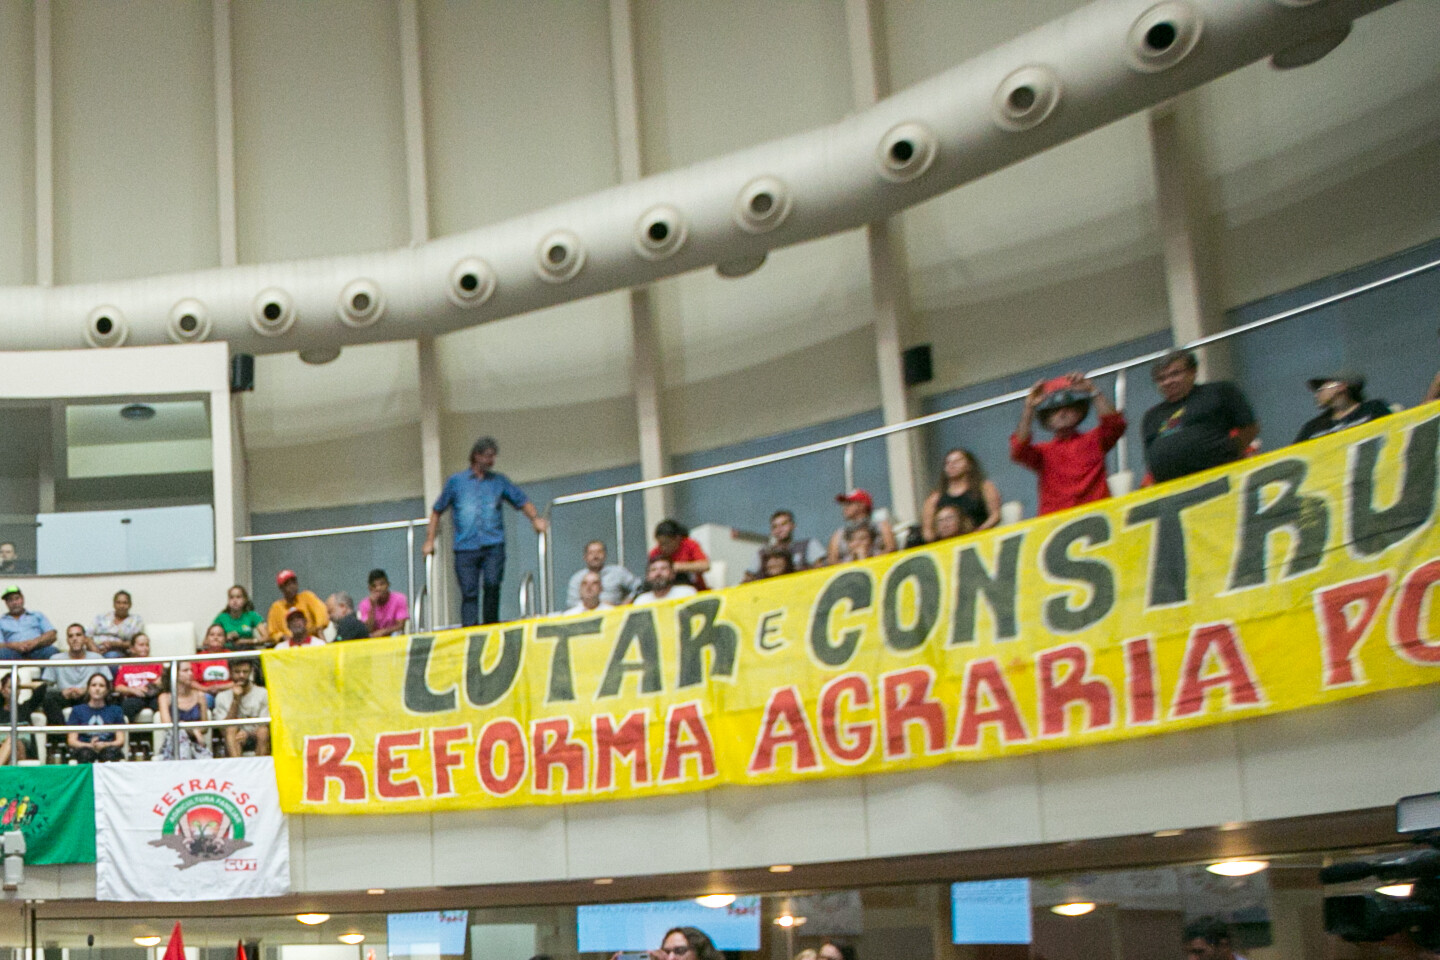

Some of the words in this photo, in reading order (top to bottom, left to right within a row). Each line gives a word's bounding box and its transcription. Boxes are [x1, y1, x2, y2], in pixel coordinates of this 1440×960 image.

[403, 597, 739, 713] LUTAR
[809, 416, 1440, 668] CONSTRU
[303, 699, 718, 804] REFORMA
[747, 621, 1266, 776] AGRARIA
[152, 778, 259, 818] FETRAF-SC
[224, 859, 257, 871] CUT
